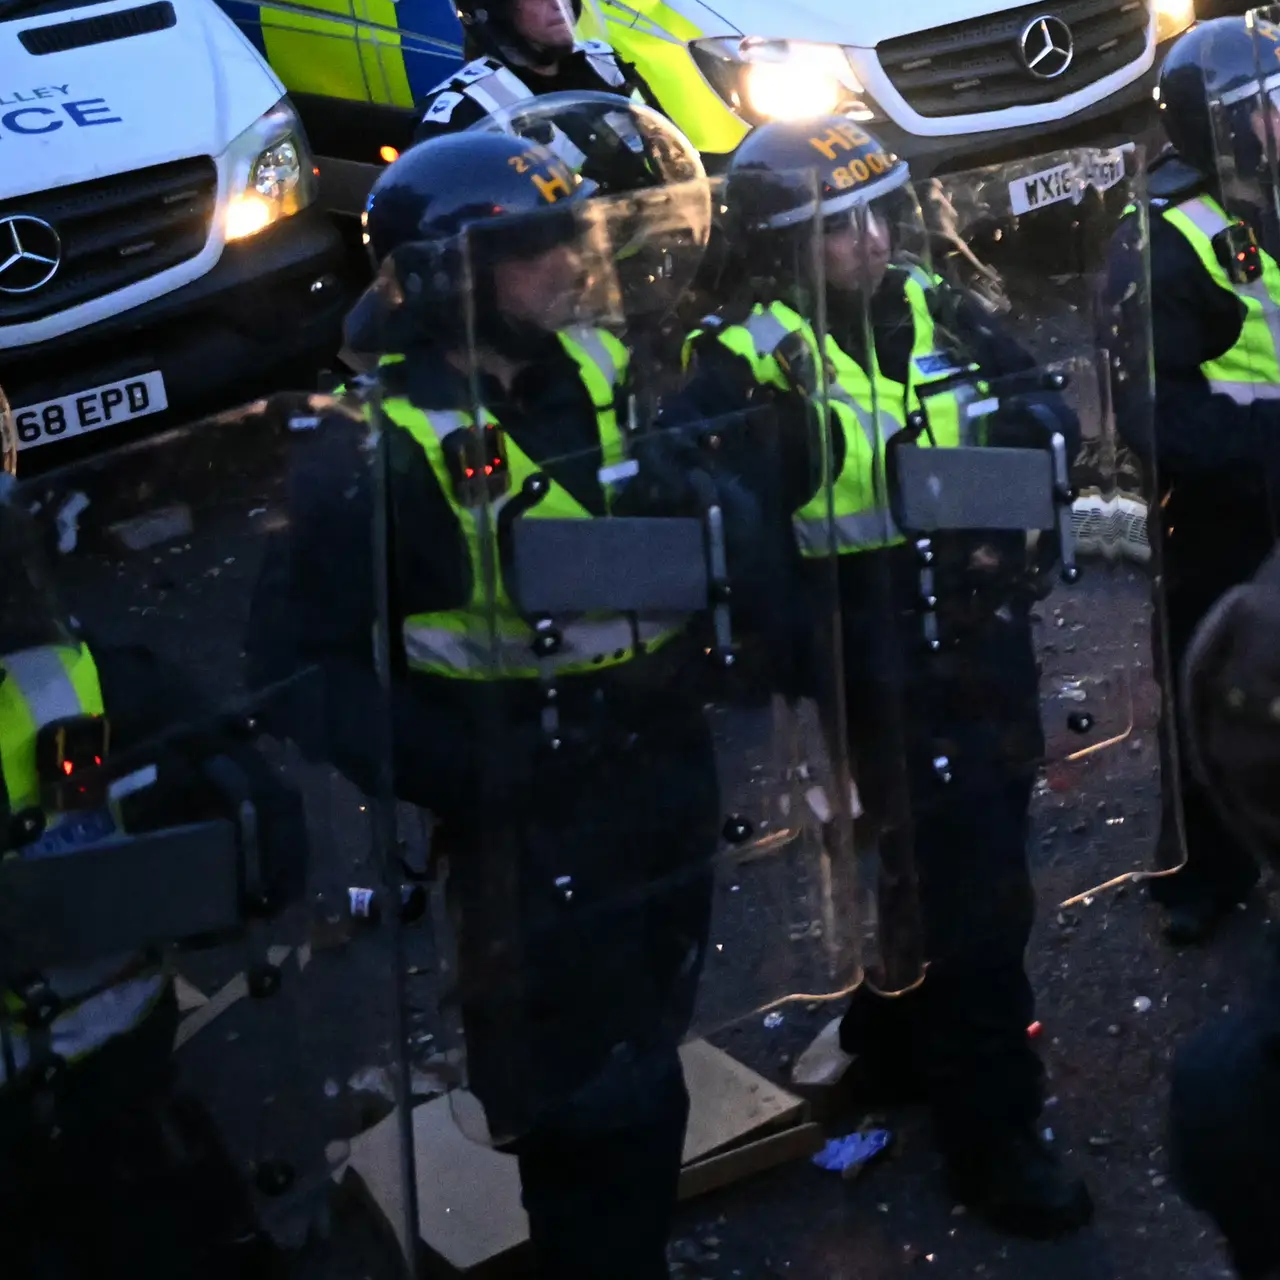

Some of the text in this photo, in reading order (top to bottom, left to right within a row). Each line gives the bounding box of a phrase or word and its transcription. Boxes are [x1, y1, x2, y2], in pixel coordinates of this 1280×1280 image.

[0, 98, 123, 136] CE
[16, 381, 149, 442] 68 EPD
